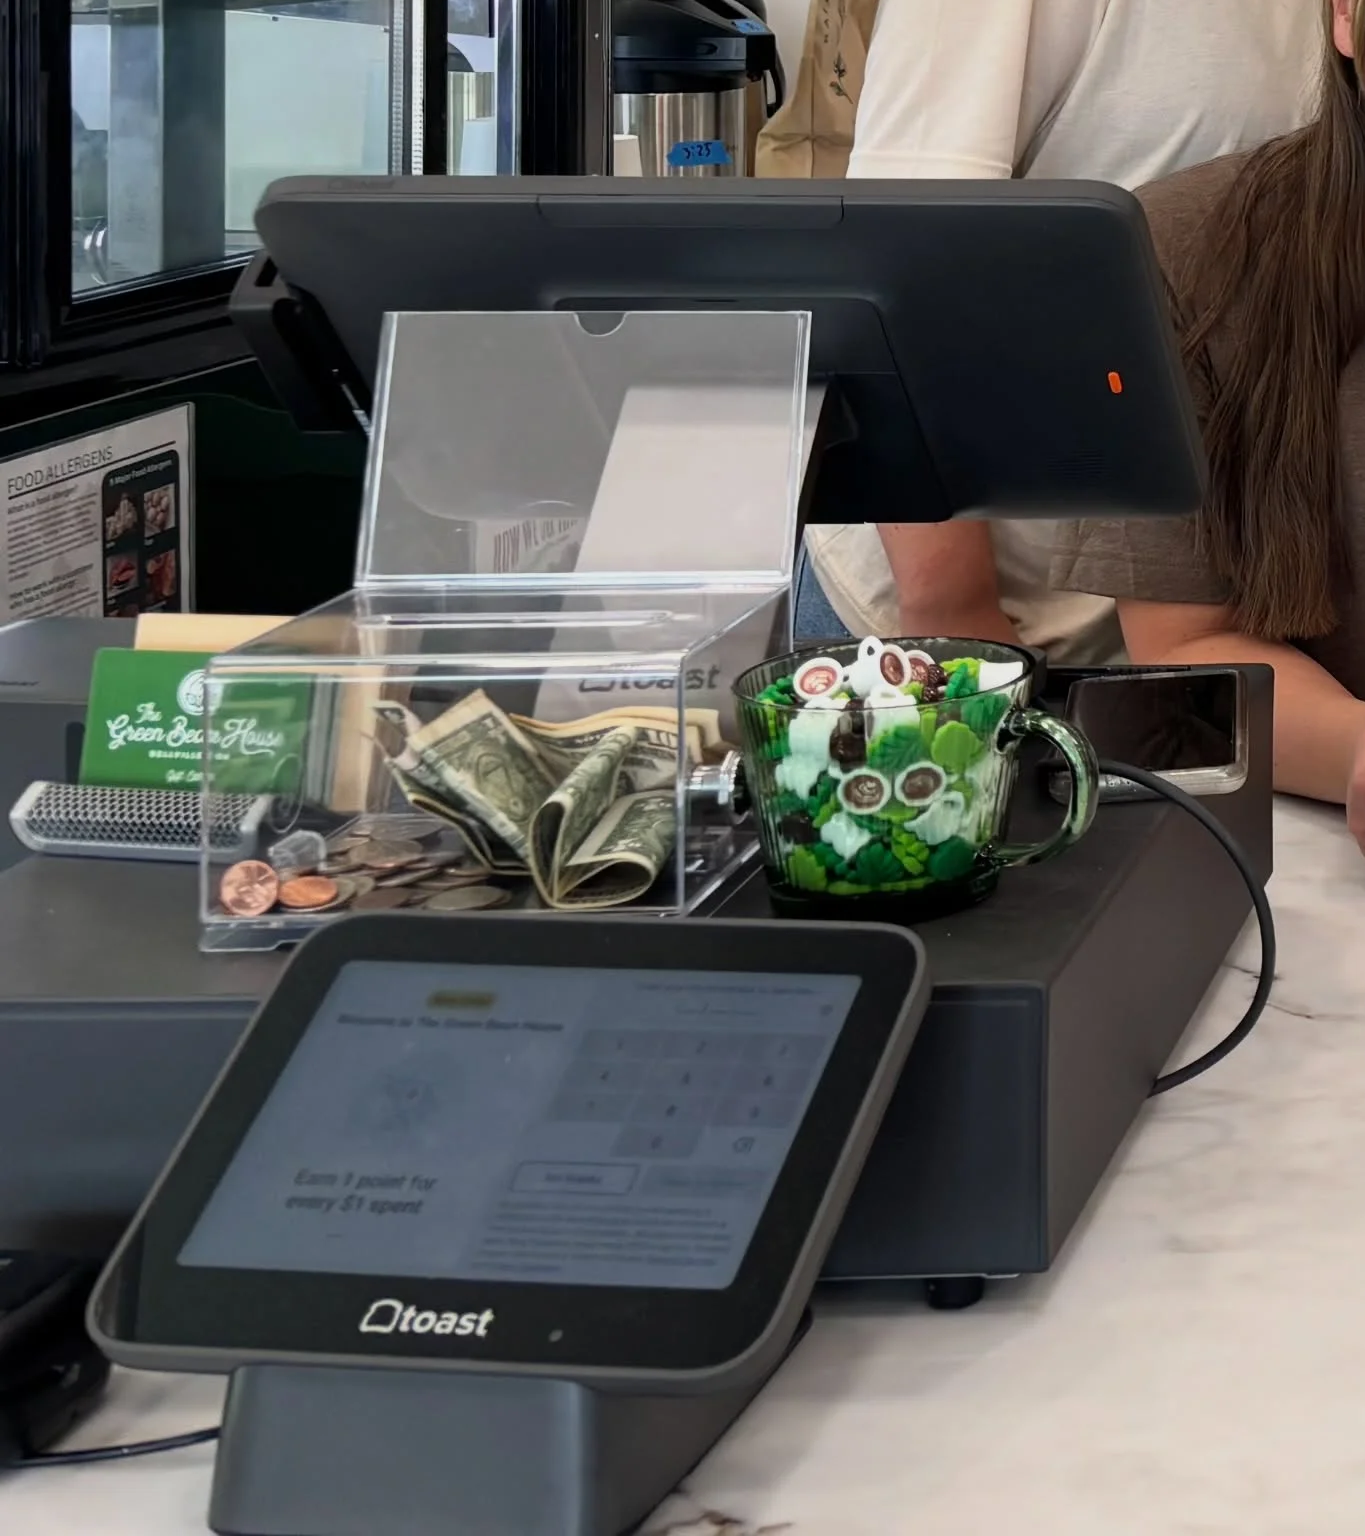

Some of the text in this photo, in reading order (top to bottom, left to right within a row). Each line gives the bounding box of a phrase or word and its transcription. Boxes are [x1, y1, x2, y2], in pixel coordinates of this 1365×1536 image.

[7, 469, 44, 494] FOOD
[45, 445, 113, 481] ALLERGENS
[135, 701, 162, 724] The
[106, 714, 165, 750] Green
[401, 1306, 495, 1338] toast
